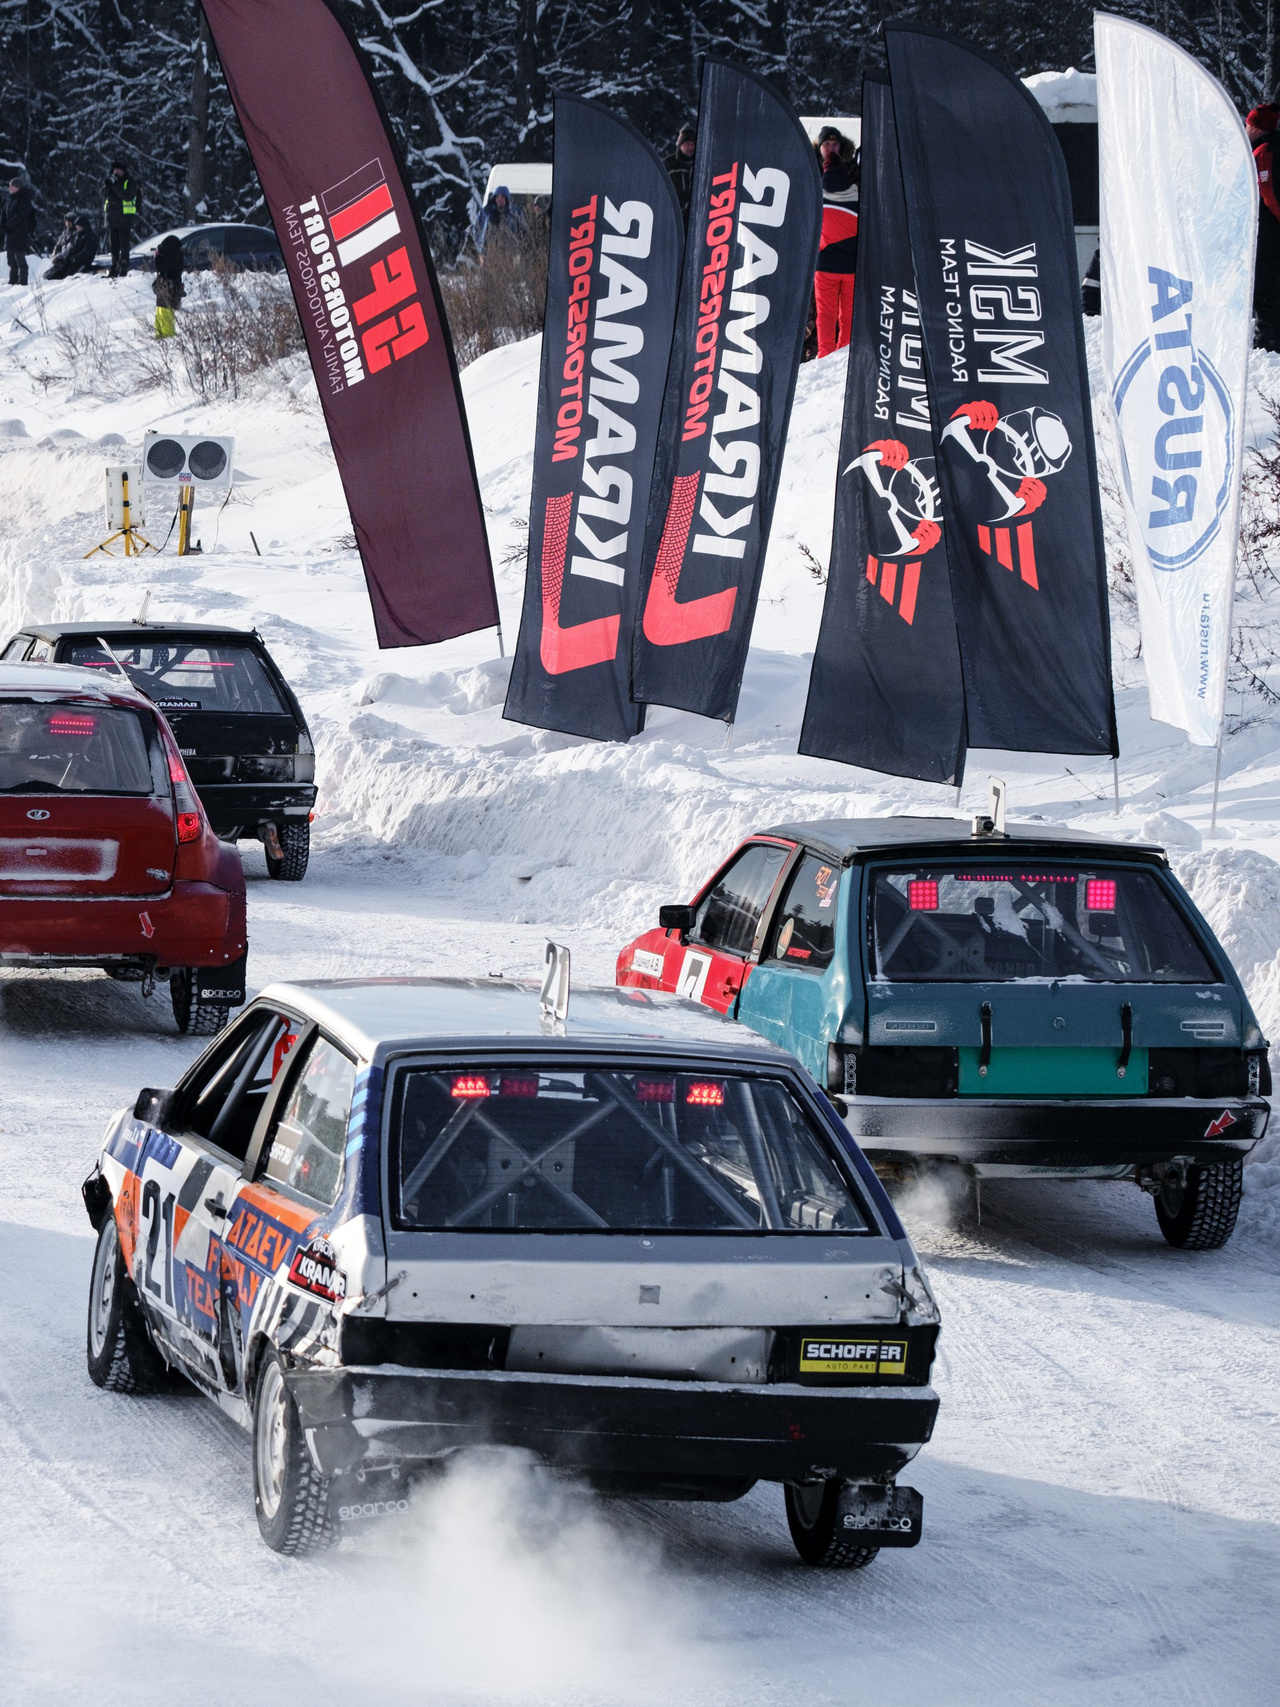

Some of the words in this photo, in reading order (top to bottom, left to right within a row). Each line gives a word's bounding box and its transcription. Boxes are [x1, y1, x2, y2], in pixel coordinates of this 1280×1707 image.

[142, 1179, 176, 1309] 21
[185, 1265, 220, 1321] TEA
[806, 1343, 902, 1360] SCHOFFER
